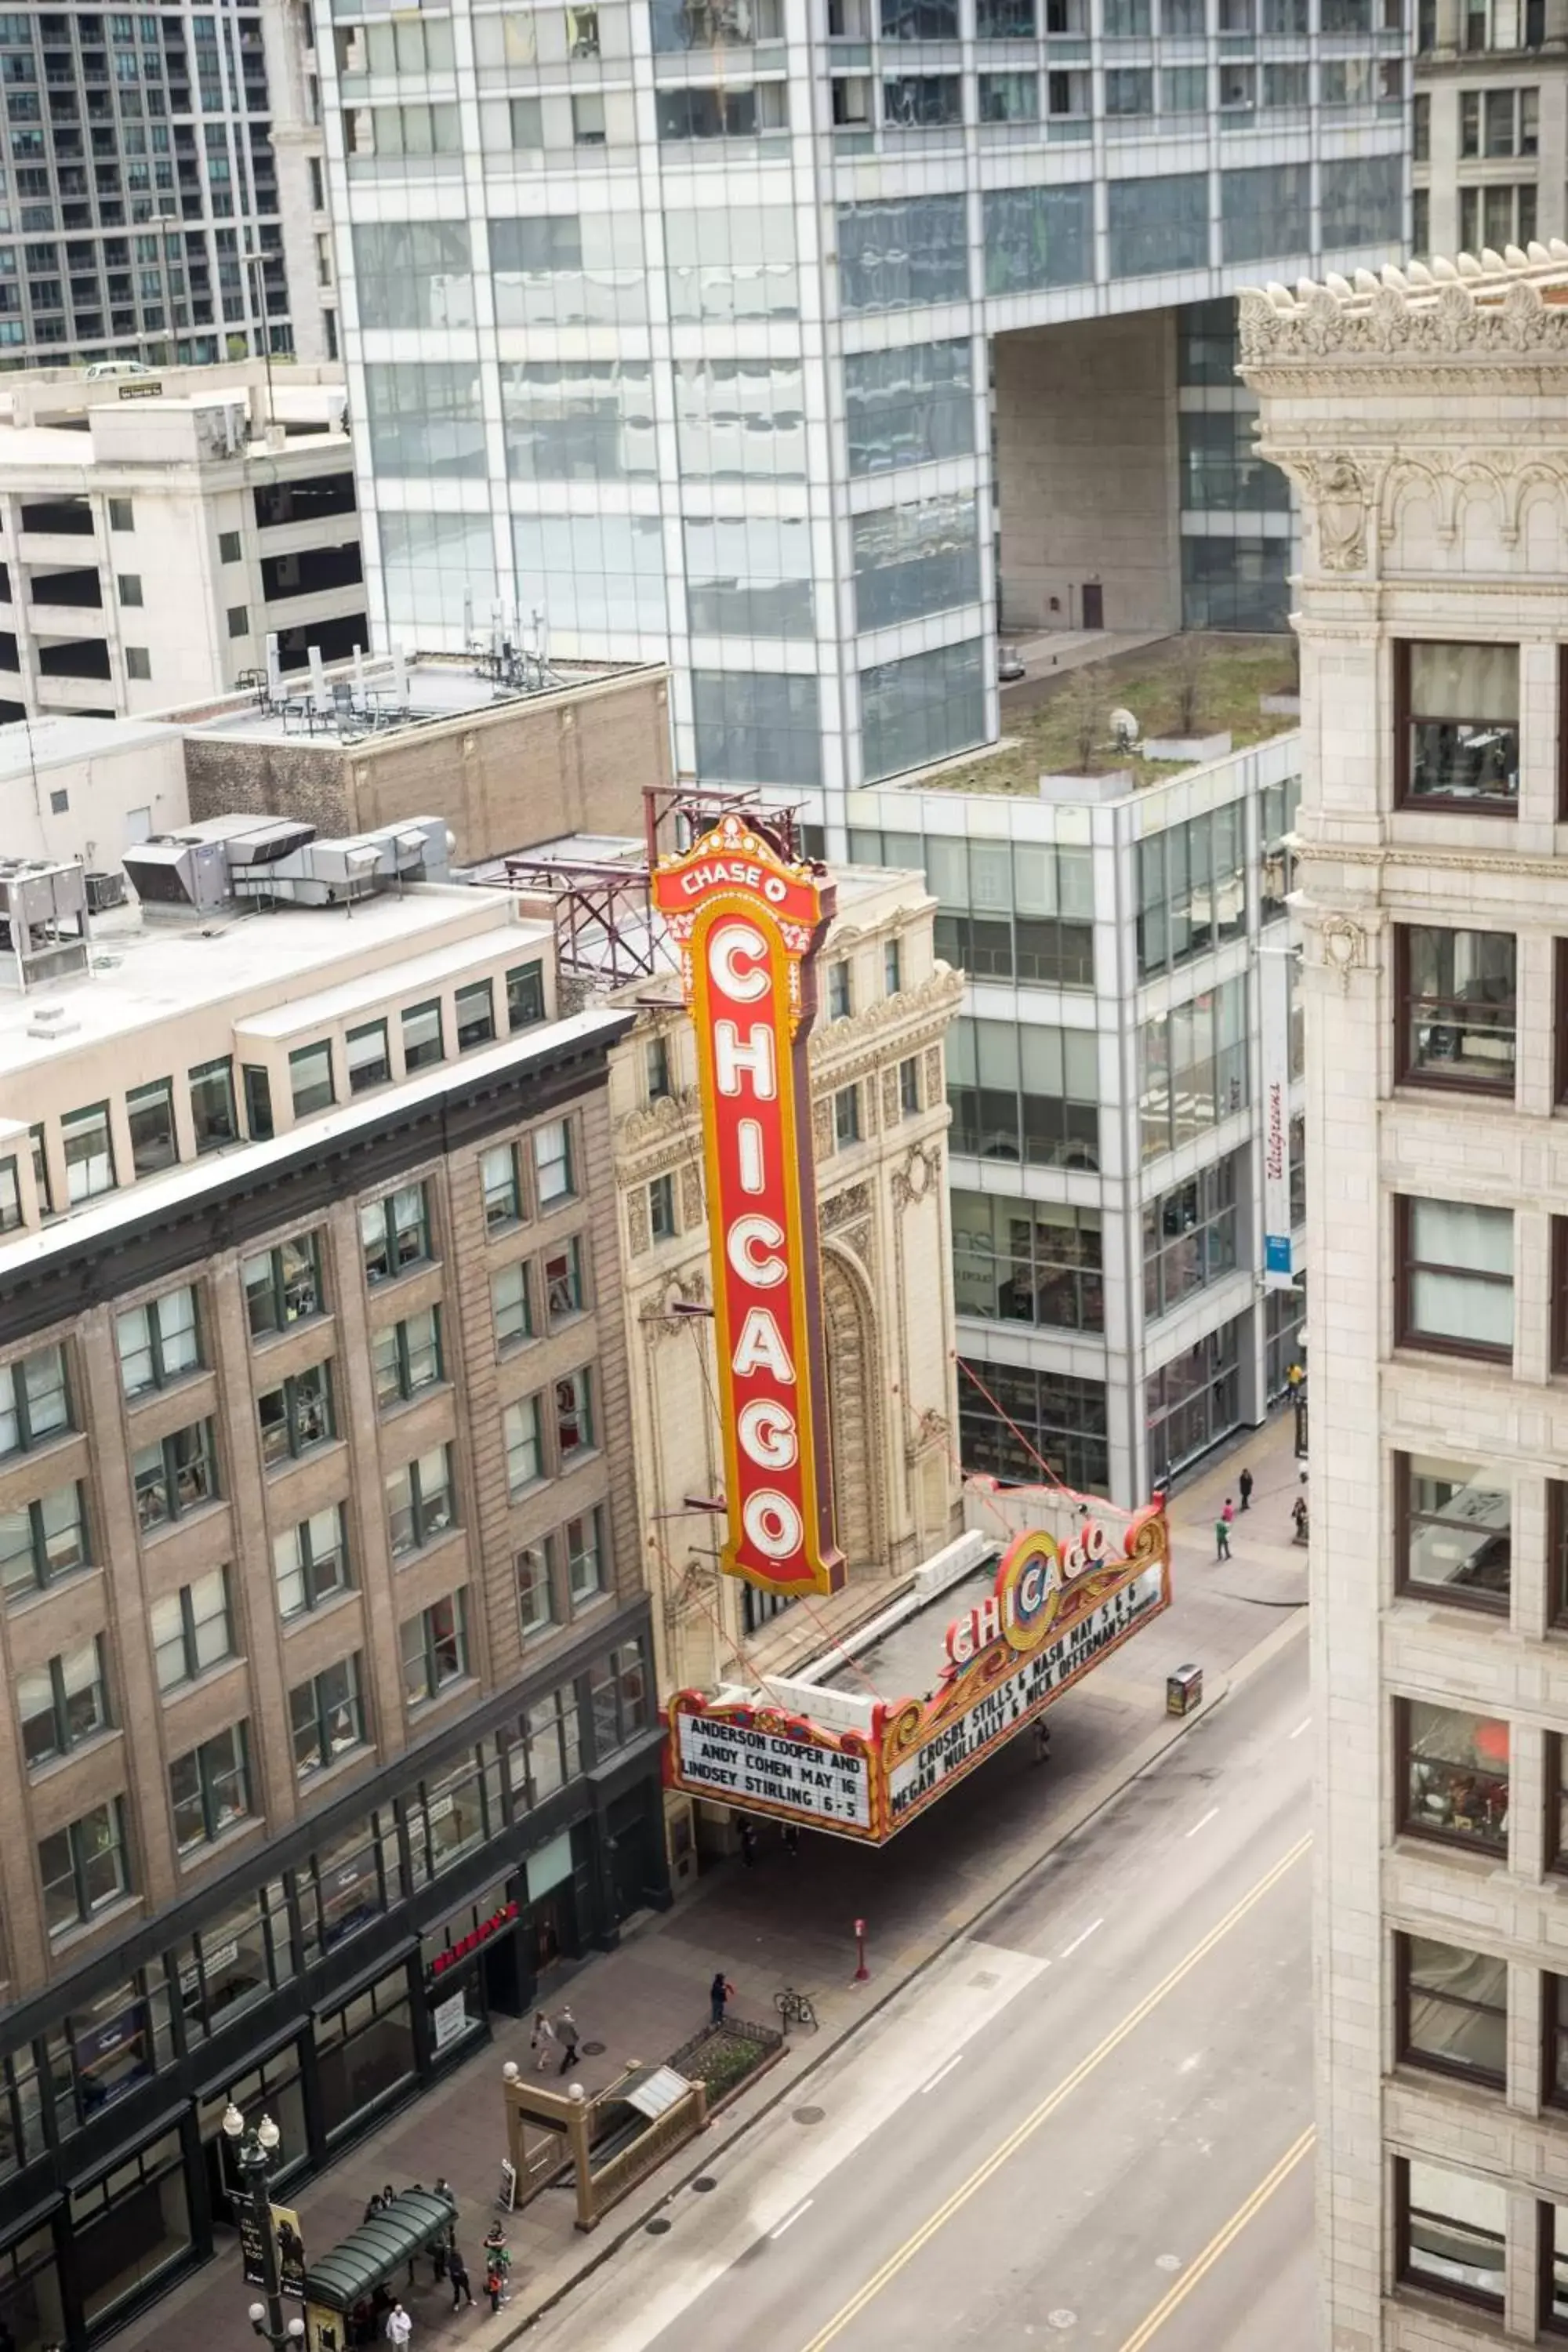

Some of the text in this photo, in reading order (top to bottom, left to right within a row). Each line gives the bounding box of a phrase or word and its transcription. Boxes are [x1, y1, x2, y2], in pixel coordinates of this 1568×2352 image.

[681, 863, 762, 895] CHASE
[1267, 1081, 1286, 1180] Walgreens
[708, 924, 804, 1559] CHICAGO
[946, 1519, 1107, 1663] CHICAGO
[891, 1766, 935, 1816] MEGAN
[943, 1708, 1005, 1773] MULLALLY
[1026, 1670, 1053, 1707] NICK
[1059, 1618, 1116, 1679] OFFERMAN
[918, 1717, 965, 1770] CROSBY
[971, 1681, 1014, 1727] STILLS
[1033, 1640, 1064, 1679] NASH
[1070, 1614, 1094, 1649] MAY
[1102, 1604, 1109, 1624] 5
[681, 1759, 738, 1786] LINDSEY
[745, 1776, 813, 1806] STIRLING
[691, 1719, 861, 1774] ANDERSON COOPER AND
[701, 1743, 856, 1795] ANDY COHEN MAY 16
